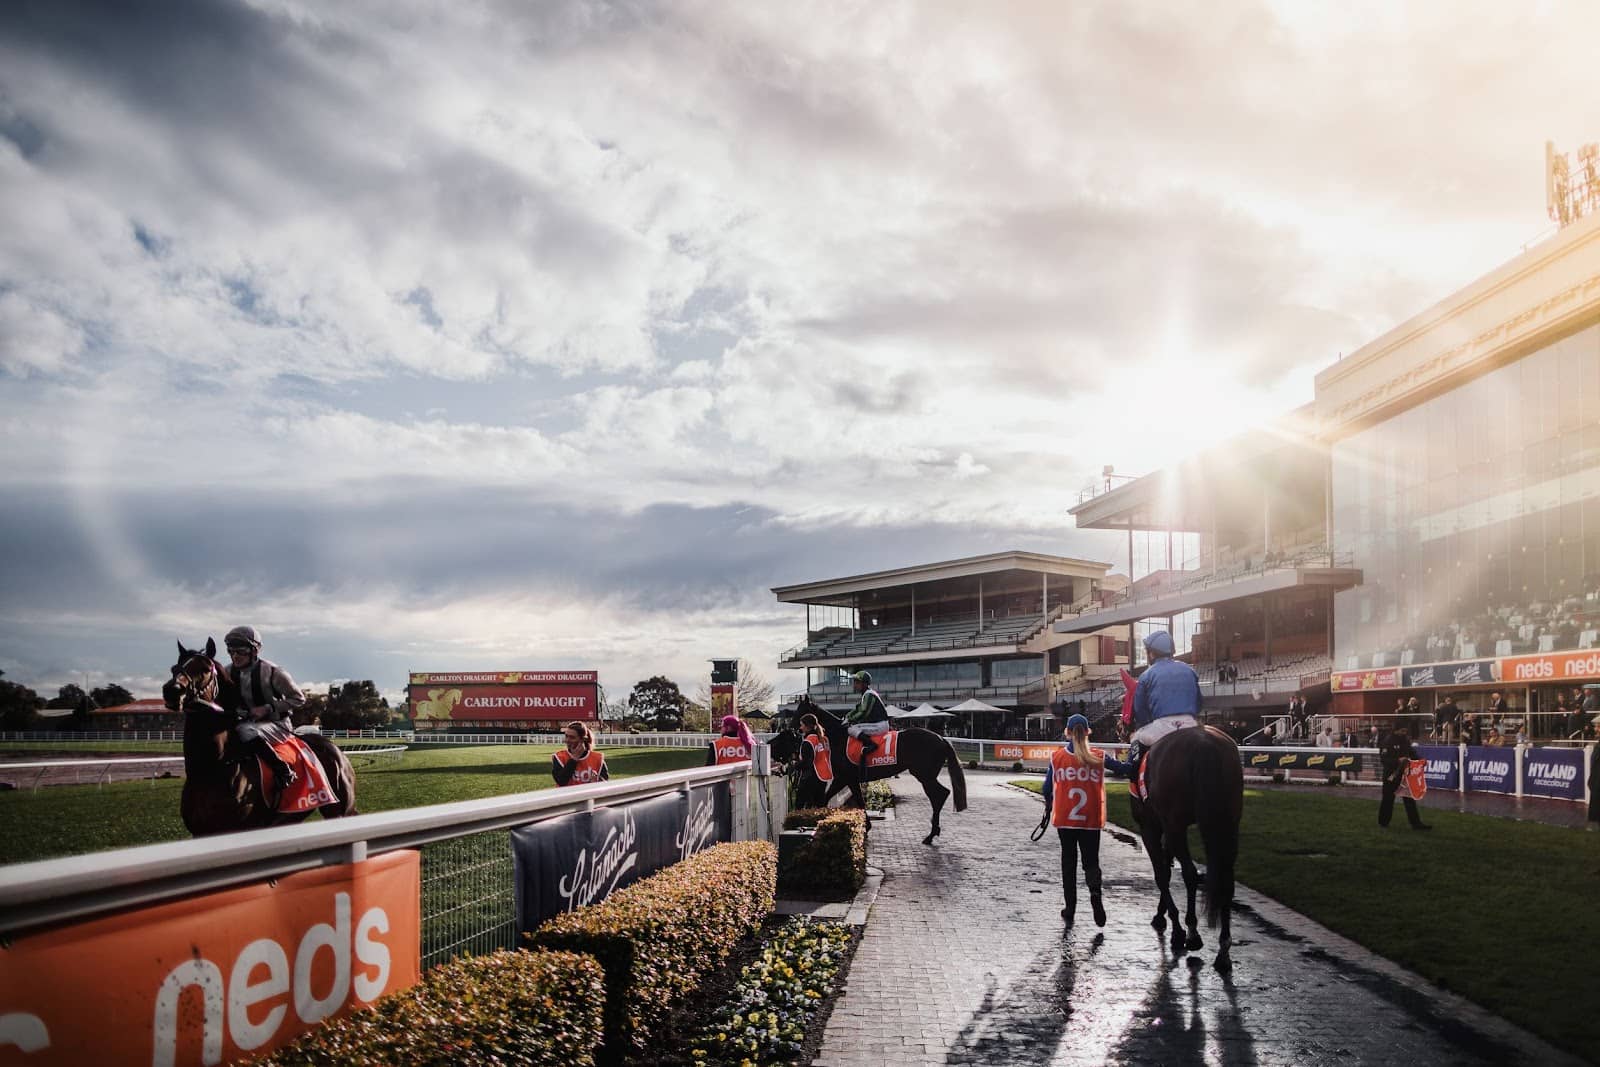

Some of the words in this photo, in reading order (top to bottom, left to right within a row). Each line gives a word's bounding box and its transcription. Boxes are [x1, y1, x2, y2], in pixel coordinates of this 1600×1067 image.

[1515, 658, 1553, 679] neds
[464, 697, 521, 708] CARLTON
[524, 696, 586, 707] DRAUGHT
[883, 733, 892, 755] 1
[1000, 747, 1024, 758] neds
[872, 754, 895, 765] neds
[1029, 747, 1053, 759] ned
[1055, 766, 1100, 783] neds
[1467, 760, 1509, 775] HYLAND
[1528, 762, 1577, 780] HYLAND
[1068, 787, 1088, 821] 2
[152, 891, 392, 1067] neds
